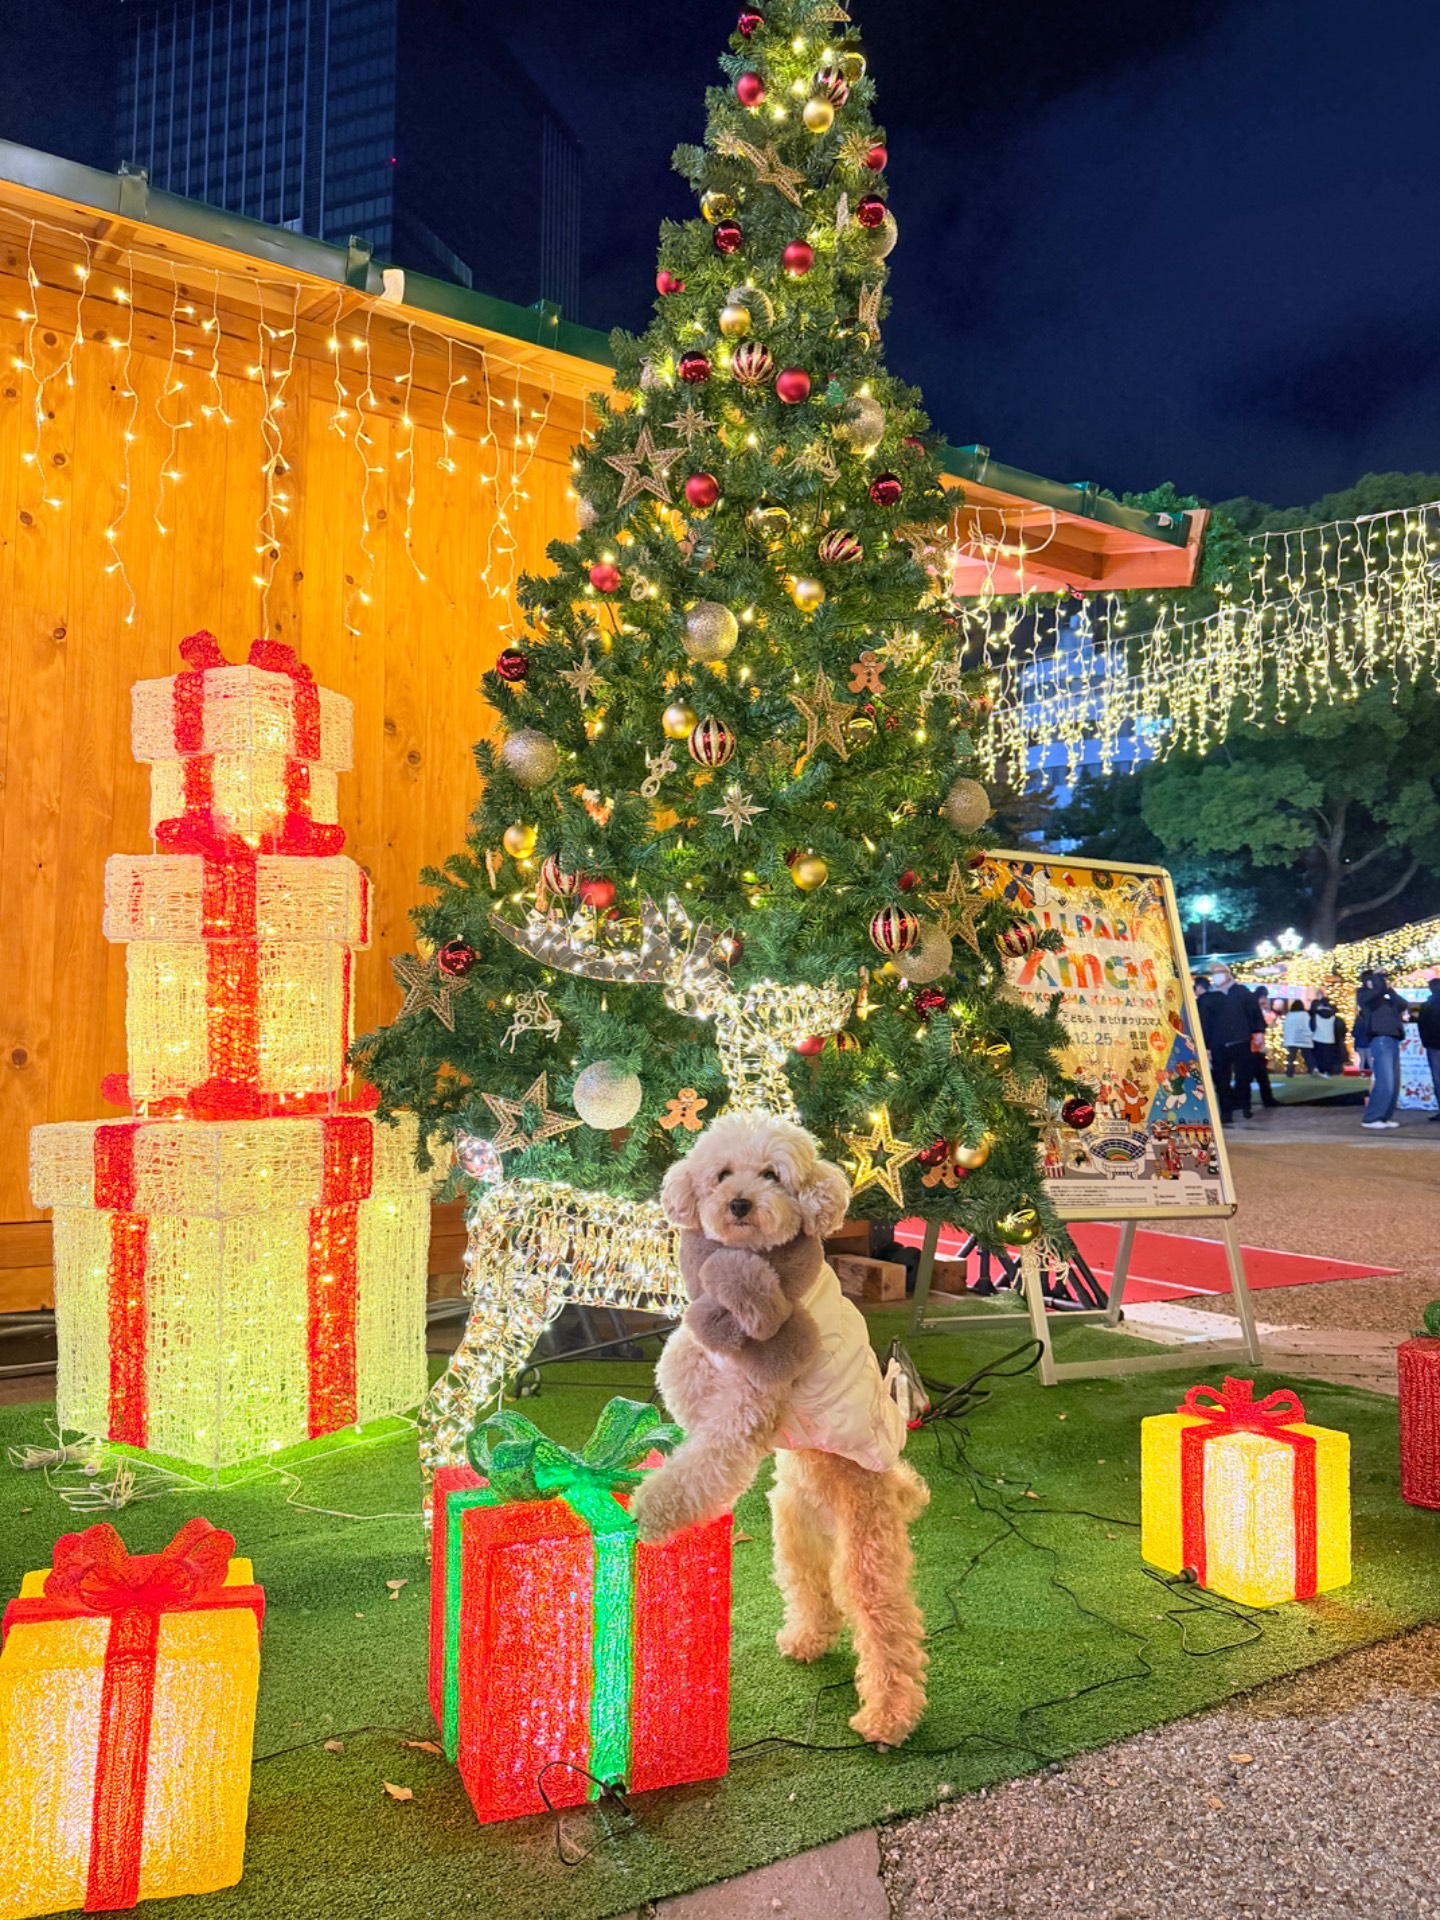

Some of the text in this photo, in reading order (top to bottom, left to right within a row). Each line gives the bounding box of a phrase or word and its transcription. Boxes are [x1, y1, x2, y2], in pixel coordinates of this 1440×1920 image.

[1026, 910, 1143, 942] ALLPARK
[1016, 949, 1158, 992] Xmas
[1019, 991, 1087, 1005] YOKOAMA
